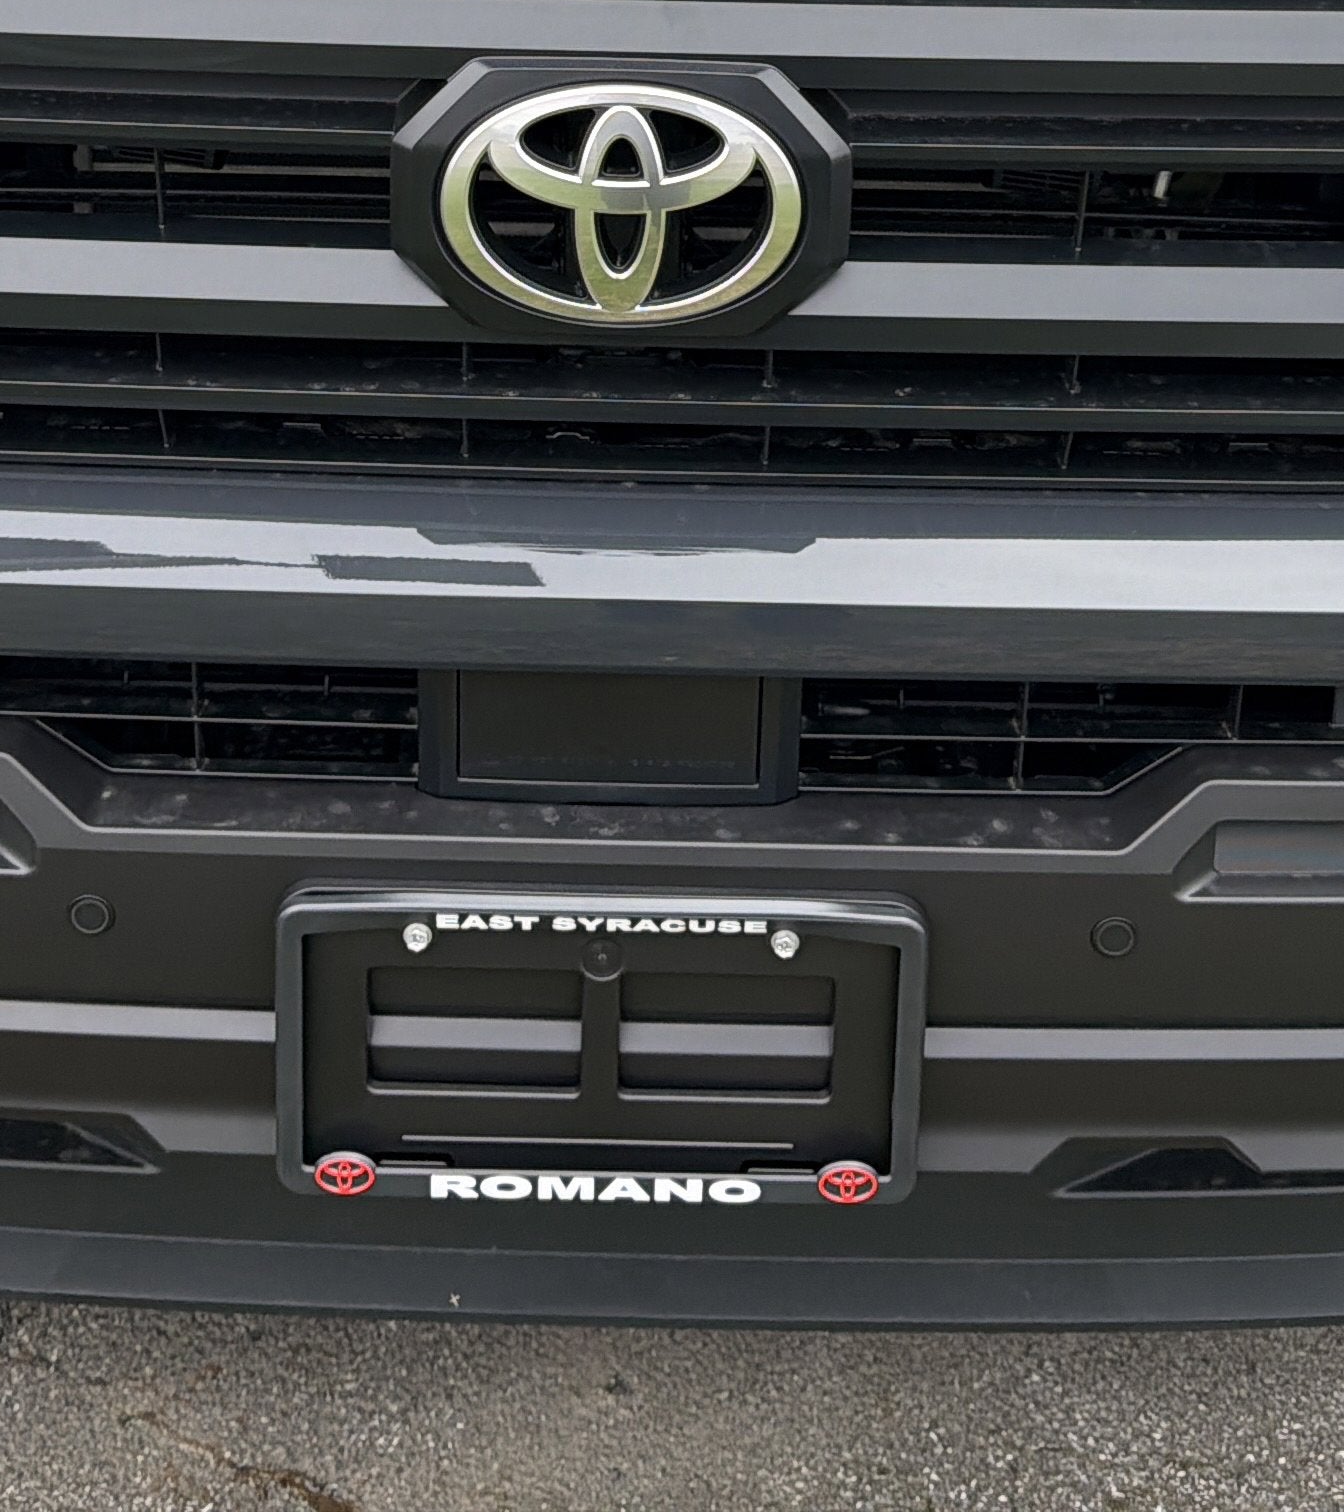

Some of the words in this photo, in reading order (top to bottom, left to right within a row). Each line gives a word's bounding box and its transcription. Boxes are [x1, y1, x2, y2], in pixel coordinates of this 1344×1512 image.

[435, 913, 540, 931] EAST
[552, 916, 768, 934] SYRACUSE
[430, 1174, 762, 1203] ROMANO
